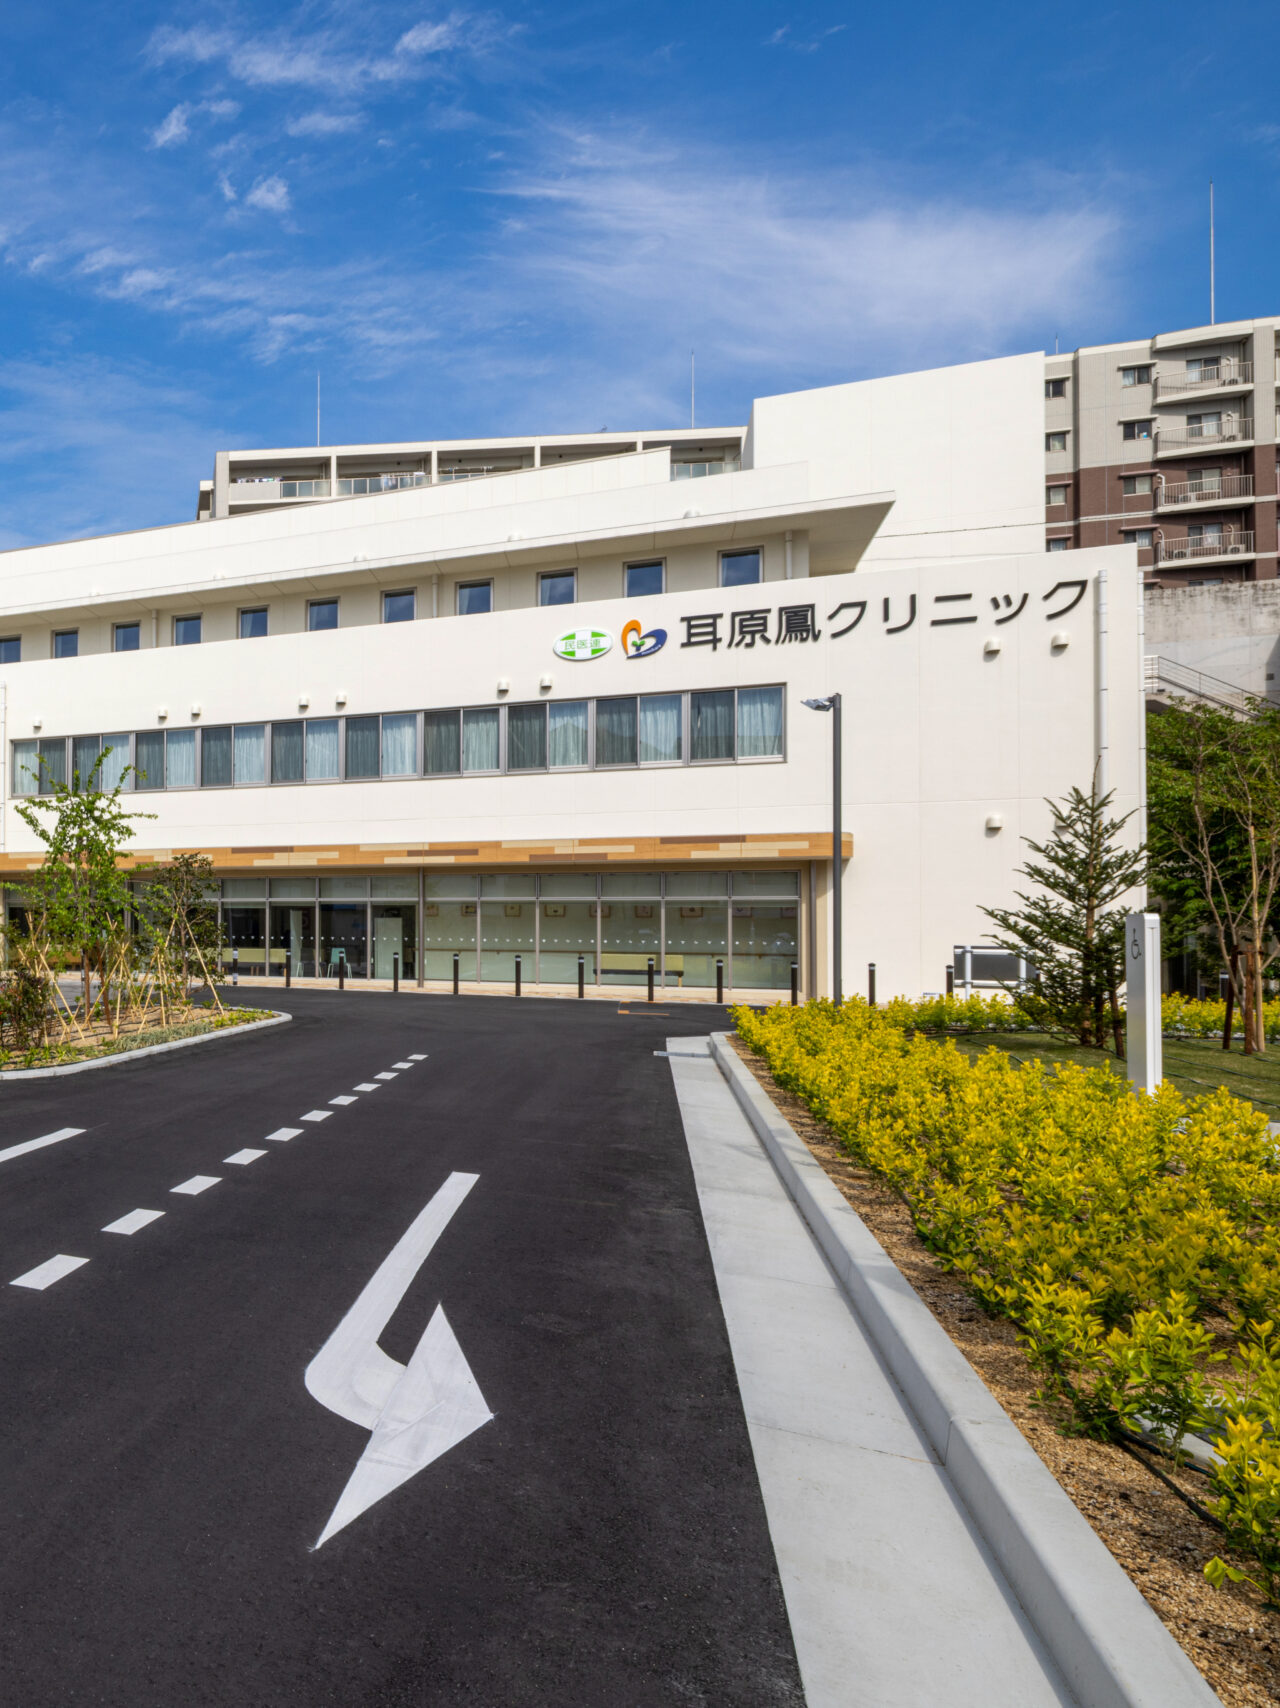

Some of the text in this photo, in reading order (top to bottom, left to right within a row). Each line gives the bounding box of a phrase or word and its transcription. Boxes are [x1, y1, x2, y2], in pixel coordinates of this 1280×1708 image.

[680, 579, 1088, 651] 耳原鳳クリニック
[564, 638, 601, 651] 民医連
